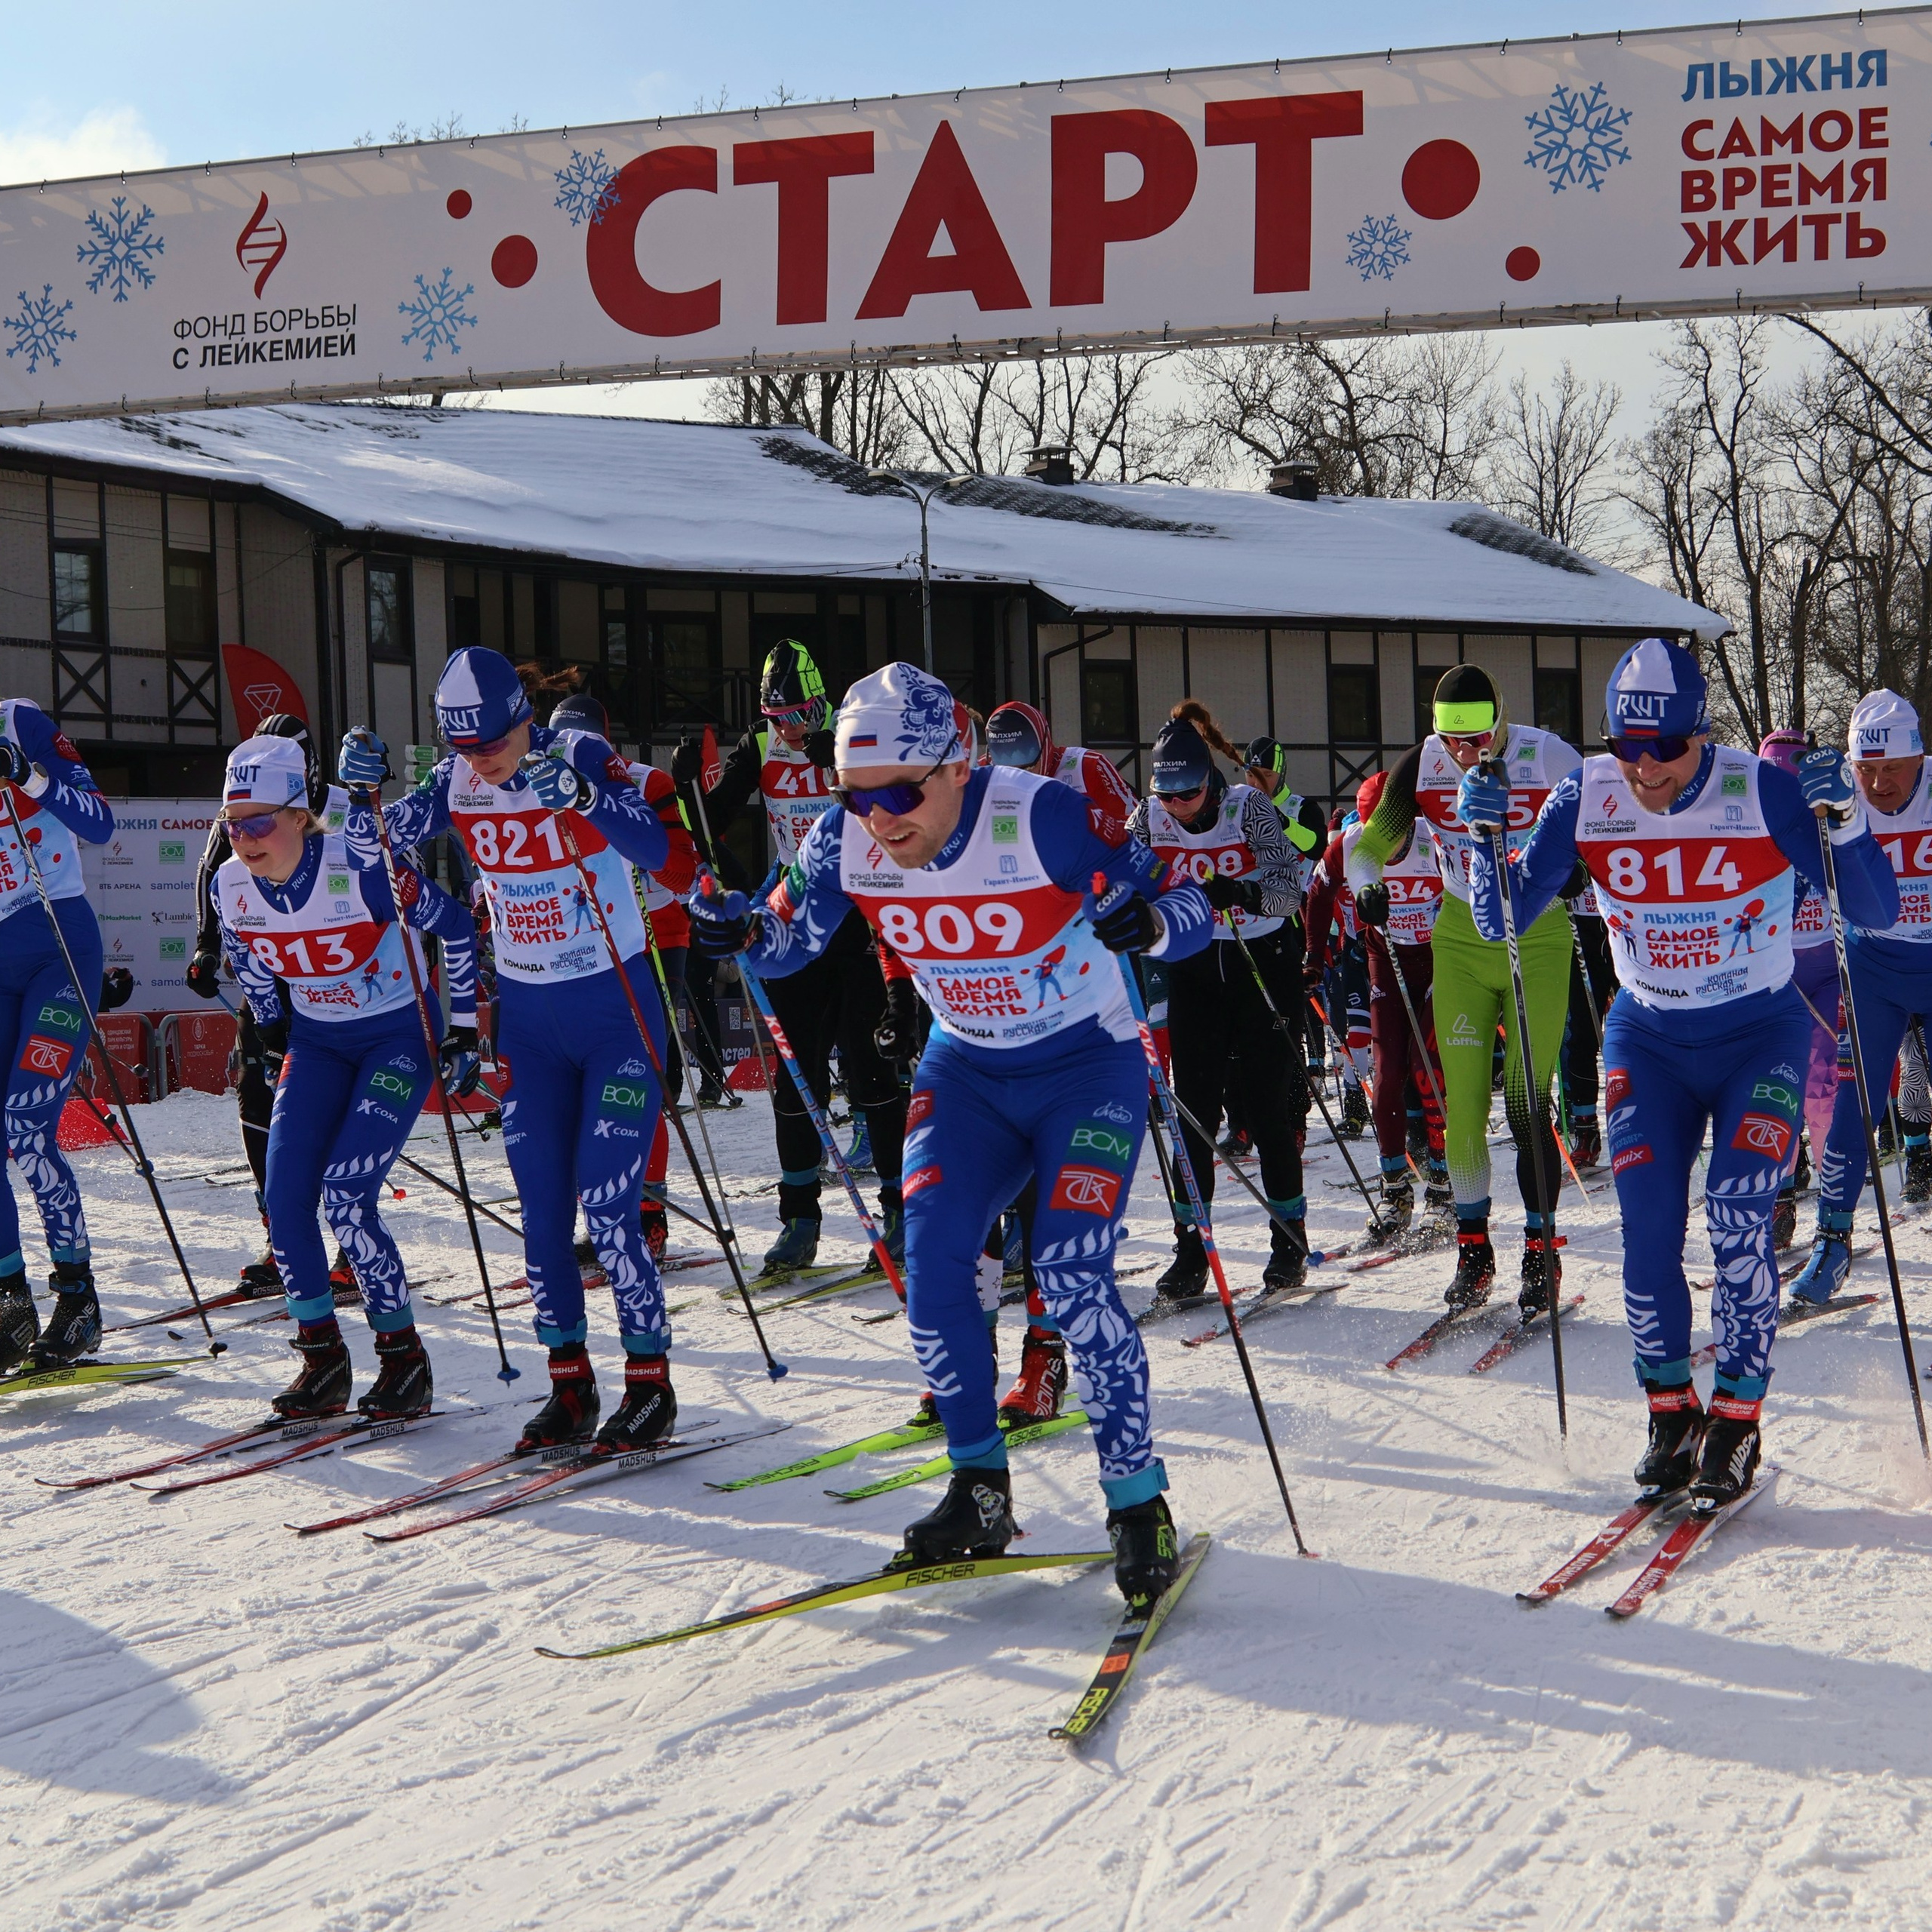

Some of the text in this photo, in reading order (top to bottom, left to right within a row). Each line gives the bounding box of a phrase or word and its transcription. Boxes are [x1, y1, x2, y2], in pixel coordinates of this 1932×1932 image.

[1681, 49, 1887, 102] ЛЫЖНЯ
[1681, 106, 1889, 161] САМОЕ
[1681, 157, 1887, 213] ВРЕМЯ
[586, 90, 1364, 337] СТАРТ
[1679, 211, 1887, 269] ЖИТЬ
[173, 303, 356, 341] ФОНД БОРЬБЫ
[172, 328, 356, 369] С ЛЕЙКЕМИЕЙ
[1616, 694, 1669, 717] RWT
[438, 707, 481, 730] RWT
[1857, 728, 1890, 744] RWT
[1806, 748, 1835, 764] COXA
[528, 760, 552, 777] COXA
[1440, 795, 1534, 828] 35
[112, 819, 214, 830] ЫЖНЯ САМОЕ
[1585, 820, 1605, 829] ФОНД
[1591, 826, 1636, 834] ЛЕЙКЕМИЕЙ
[1709, 823, 1761, 832] Гарант-Инвест
[471, 814, 565, 866] 821
[1882, 835, 1932, 874] 16
[1172, 850, 1243, 885] 408
[1607, 846, 1743, 897] 814
[848, 872, 903, 881] ФОНД БОРЬБЫ
[858, 881, 904, 889] ЛЕЙКЕМИЕЙ
[983, 874, 1040, 887] Гарант-Инвест
[151, 881, 195, 890] samolet
[383, 847, 408, 935] SWIX
[502, 881, 556, 897] ЛЫЖНЯ
[1385, 880, 1434, 902] 84
[1899, 883, 1928, 892] ЖНЯ
[1096, 881, 1127, 912] COXA
[505, 897, 561, 914] САМОЕ
[323, 912, 367, 923] Гарант-Инвест
[507, 911, 564, 928] ВРЕМЯ
[1644, 911, 1717, 924] ЛЫЖНЯ
[1792, 920, 1823, 932] ИТЬ
[878, 902, 1024, 953] 809
[1645, 926, 1720, 943] САМОЕ
[1828, 886, 1848, 974] SWIX
[509, 929, 567, 945] ЖИТЬ
[1503, 897, 1522, 980] SWIX
[252, 932, 355, 974] 813
[558, 944, 596, 961] КОМАНДА
[1648, 950, 1721, 970] ЖИТЬ
[503, 957, 545, 973] КОМАНДА
[550, 957, 583, 971] РУССКАЯ
[575, 960, 598, 973] ЗИМА
[930, 965, 1011, 975] ЛЫЖНЯ
[151, 978, 187, 986] samole
[937, 976, 1016, 990] САМОЕ
[1707, 966, 1749, 985] КОМАНДА
[1635, 978, 1689, 998] КОМАНДА
[1695, 978, 1734, 995] РУССКАЯ
[1724, 982, 1748, 996] ЗИМА
[943, 988, 1023, 1003] ВРЕМЯ
[946, 1001, 1028, 1017] ЖИТЬ
[939, 1012, 995, 1038] КОМАНДА
[374, 1106, 398, 1124] COXA
[613, 1126, 639, 1138] COXA
[1614, 1150, 1644, 1171] swix
[253, 1284, 286, 1297] ROSSIGNO
[334, 1290, 362, 1303] ROSSIGNO
[63, 1301, 97, 1345] SPINE
[27, 1369, 76, 1388] FISCHER
[311, 1359, 346, 1395] MADSHUS
[396, 1362, 424, 1396] MADSHUS
[625, 1367, 661, 1376] MADSHUS
[1652, 1391, 1693, 1404] MADSHUS
[1712, 1400, 1756, 1411] MADSHUS
[626, 1393, 660, 1434] MADSHUS
[281, 1421, 318, 1437] MADSHUS
[370, 1423, 405, 1439] MADSHUS
[926, 1423, 946, 1438] FISC
[1009, 1425, 1043, 1445] FISCHER
[541, 1446, 580, 1463] MADSHUS
[618, 1452, 657, 1470] MADSHUS
[906, 1562, 976, 1587] FISCHER
